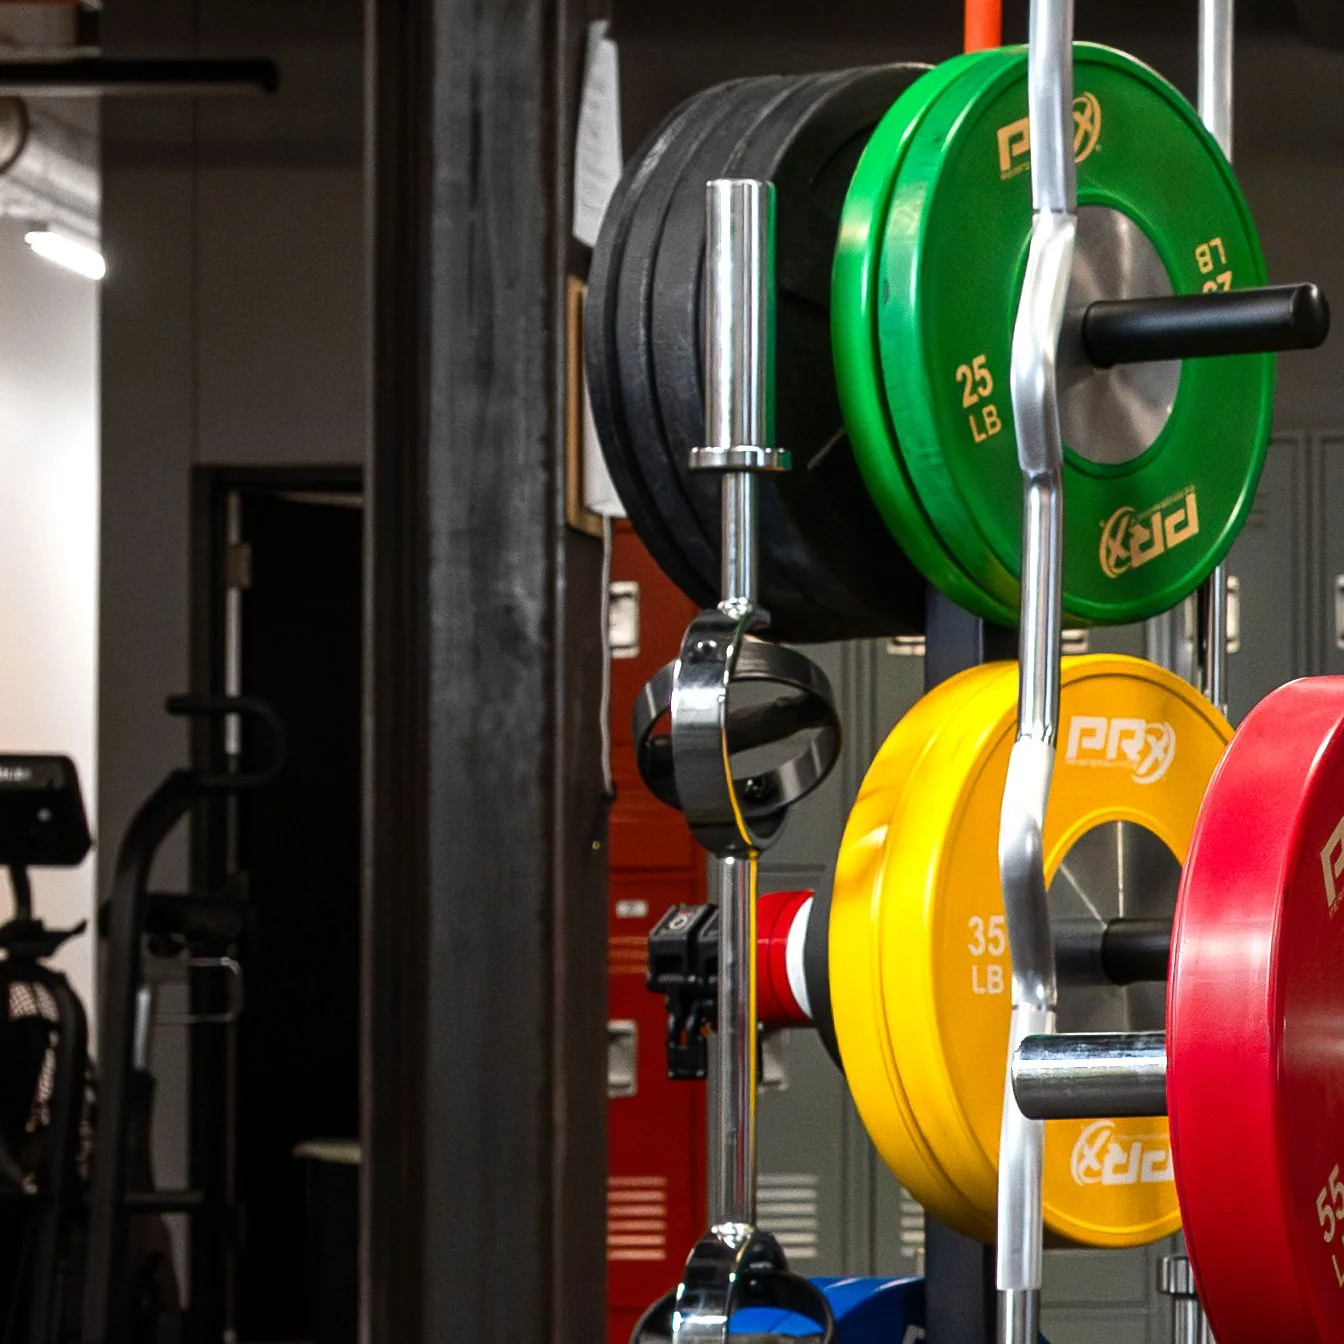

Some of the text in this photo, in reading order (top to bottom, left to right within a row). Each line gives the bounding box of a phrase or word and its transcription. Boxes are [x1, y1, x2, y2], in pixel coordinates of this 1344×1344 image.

[1195, 238, 1227, 274] LB
[955, 355, 993, 408] 25
[968, 404, 1003, 444] LB
[967, 915, 1006, 956] 35
[971, 964, 1005, 994] LB
